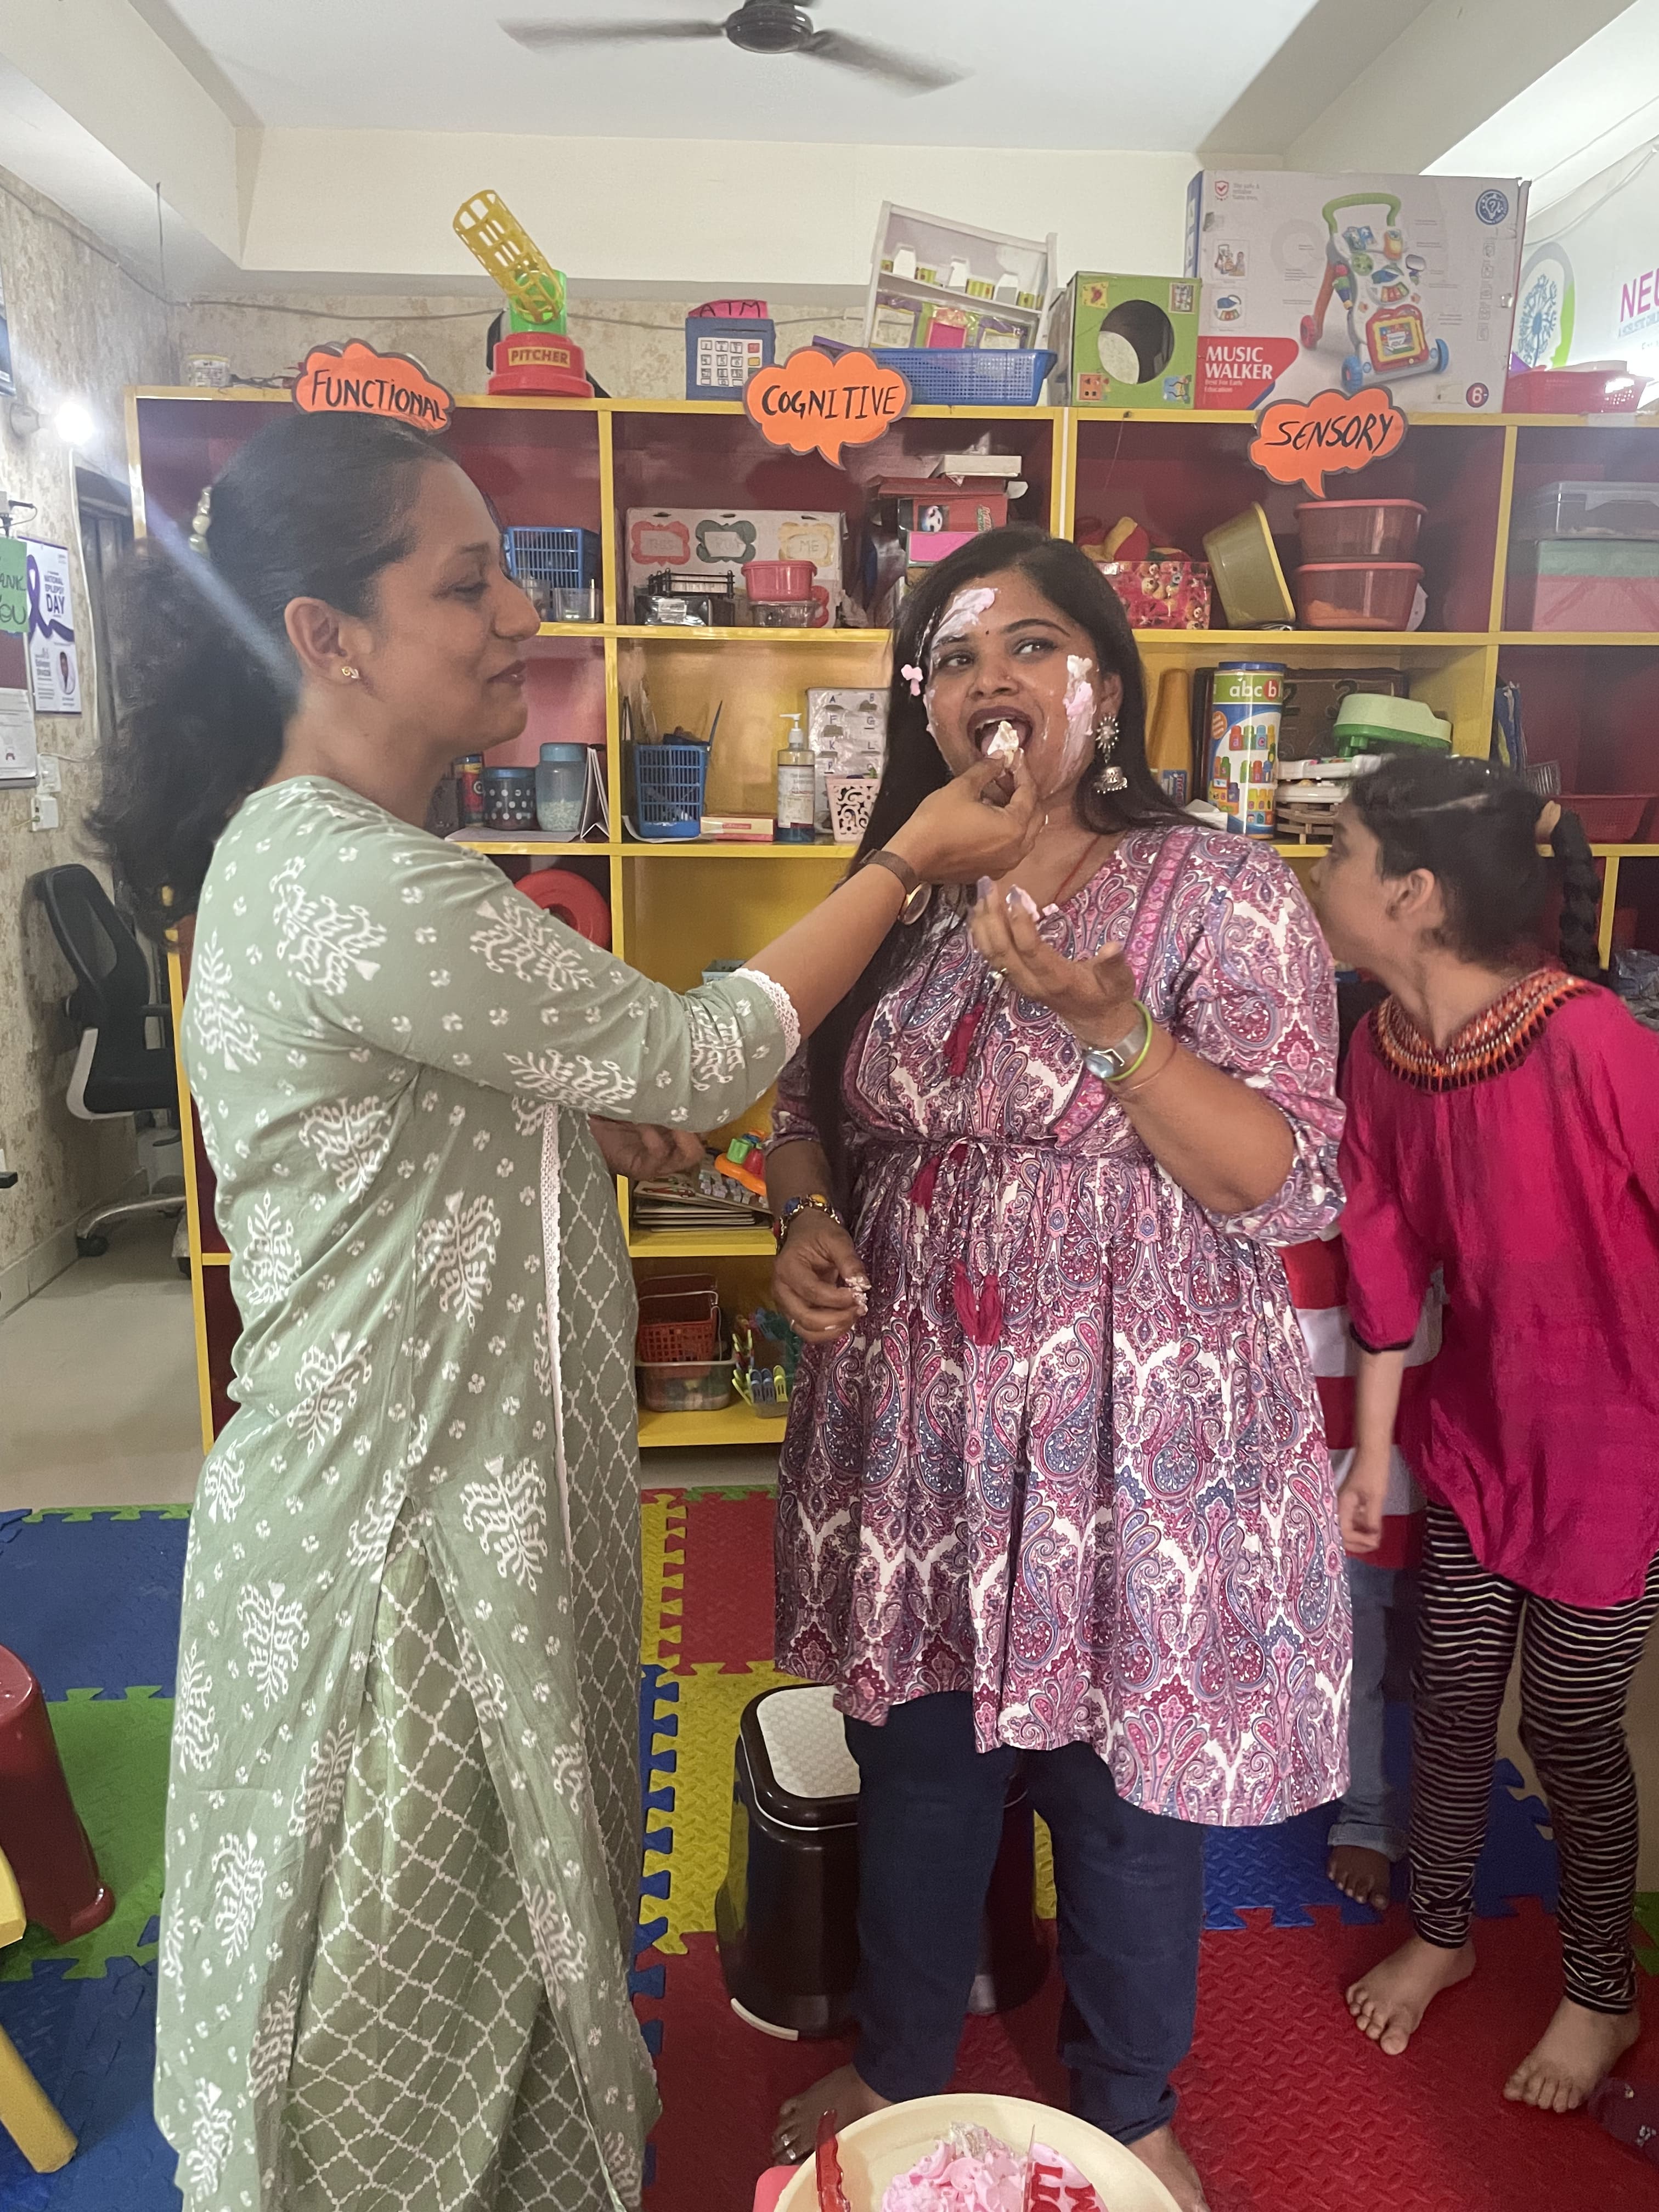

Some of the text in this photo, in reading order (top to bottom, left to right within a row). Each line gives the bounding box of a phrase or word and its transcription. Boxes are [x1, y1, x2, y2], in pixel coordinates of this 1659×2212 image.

[699, 302, 761, 318] ATM
[511, 349, 568, 364] PITCHER
[1206, 346, 1263, 362] MUSIC
[1205, 363, 1273, 379] WALKER
[312, 369, 446, 421] FUNCTIONAL
[762, 385, 900, 419] COGNITIVE
[1264, 413, 1393, 454] SENSORY
[0, 595, 26, 624] OU
[46, 594, 65, 614] DAY
[830, 715, 875, 725] F G
[830, 741, 835, 750] K
[828, 761, 833, 770] P
